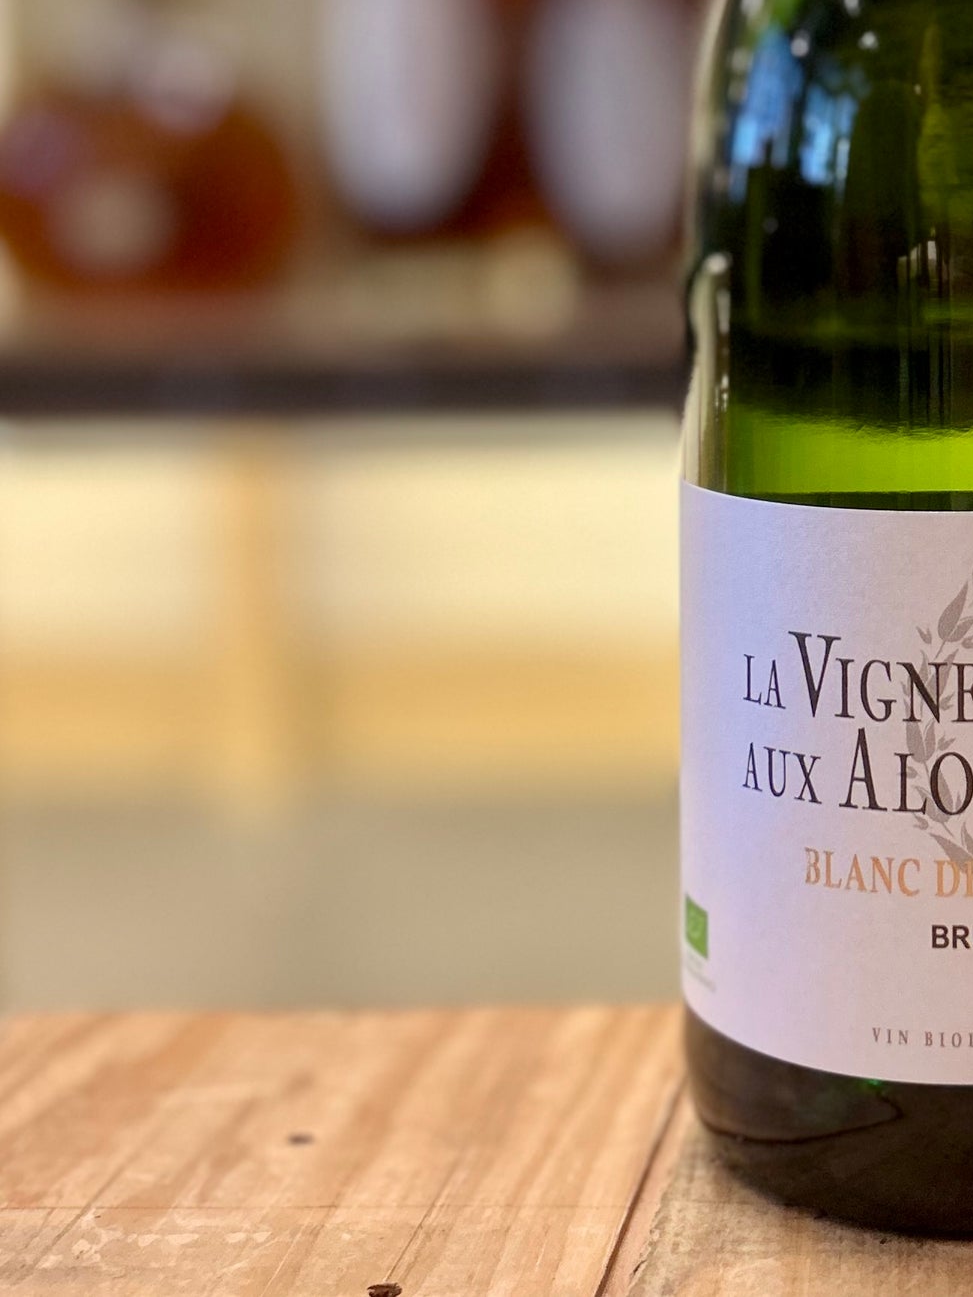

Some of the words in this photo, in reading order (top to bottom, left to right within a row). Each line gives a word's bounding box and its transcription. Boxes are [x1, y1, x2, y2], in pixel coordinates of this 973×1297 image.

[743, 654, 786, 709] LA
[743, 741, 823, 803] AUX
[804, 847, 921, 897] BLANC
[872, 1027, 909, 1045] VIN
